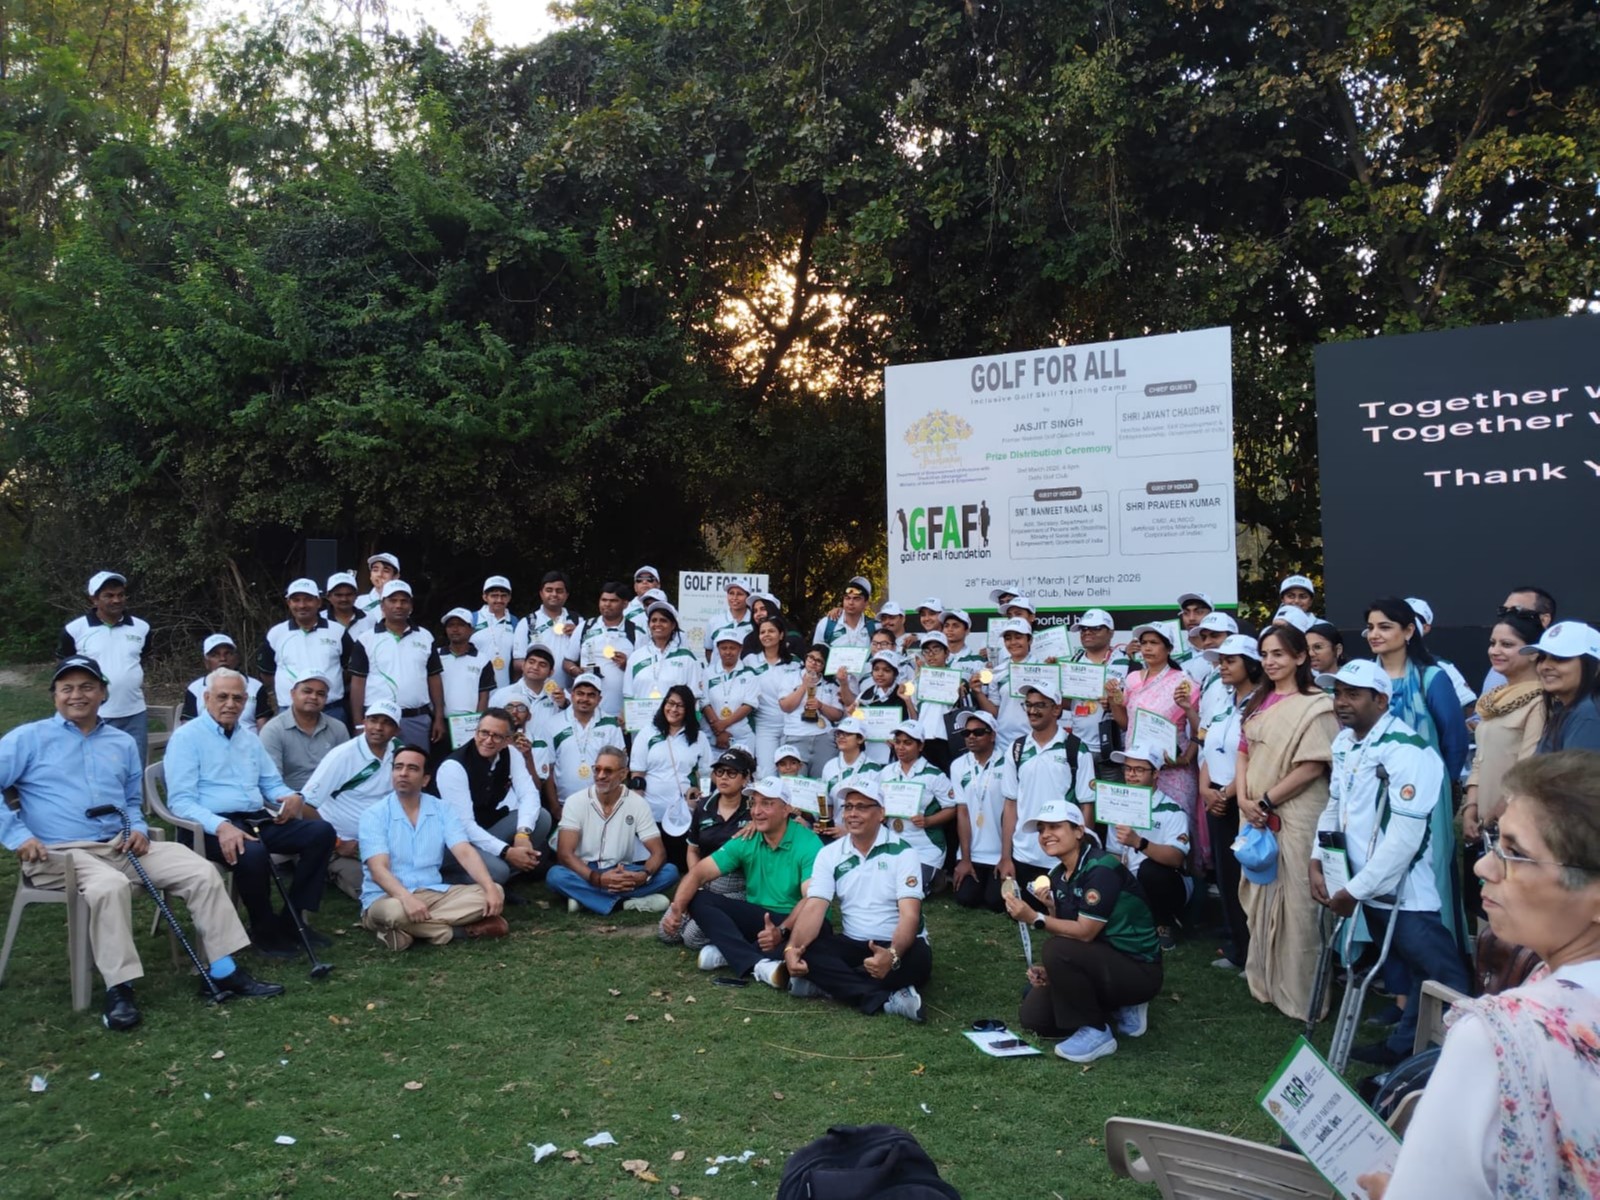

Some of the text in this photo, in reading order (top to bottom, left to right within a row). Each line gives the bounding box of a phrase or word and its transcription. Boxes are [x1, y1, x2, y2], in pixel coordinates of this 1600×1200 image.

[971, 348, 1126, 393] GOLF FOR ALL
[971, 384, 1127, 405] Inclusive Golf Skill Training Camp
[1169, 384, 1192, 392] GUEST
[1359, 387, 1569, 419] Together
[1122, 405, 1221, 422] SHRI JAYANT CHAUDHARY
[1013, 418, 1083, 433] JASJIT SINGH
[1362, 412, 1573, 443] Together
[986, 445, 1112, 461] Prize Distribution Ceremony
[1424, 462, 1568, 488] Thank
[1031, 506, 1062, 516] MANMEET
[1091, 504, 1103, 513] IAS
[1126, 497, 1221, 511] SHRI PRAVEEN KUMAR
[909, 504, 978, 551] GFAF
[900, 551, 916, 564] golf
[917, 550, 931, 561] for
[684, 575, 713, 591] GOLF
[981, 578, 1019, 588] February
[1037, 576, 1065, 585] March
[1086, 574, 1114, 583] March
[1117, 573, 1141, 583] 2026
[1038, 588, 1061, 598] Club,
[1064, 588, 1084, 597] New
[1087, 587, 1111, 596] Delhi
